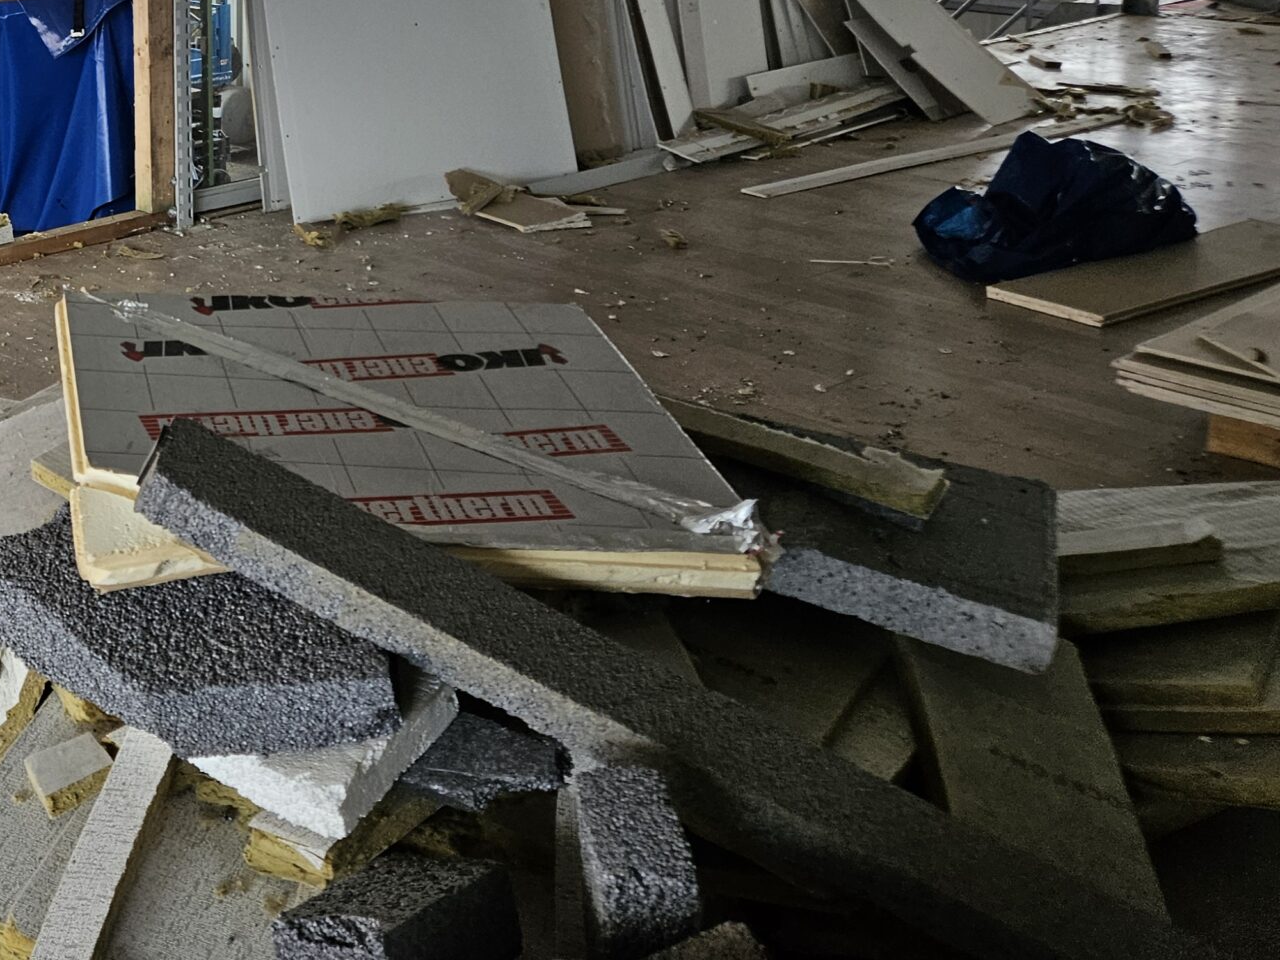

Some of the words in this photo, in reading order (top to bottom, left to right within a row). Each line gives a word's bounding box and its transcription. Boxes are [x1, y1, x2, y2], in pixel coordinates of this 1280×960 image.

[143, 340, 210, 357] IK
[436, 348, 548, 372] IKO
[317, 356, 437, 381] enert
[157, 413, 378, 436] enerthe
